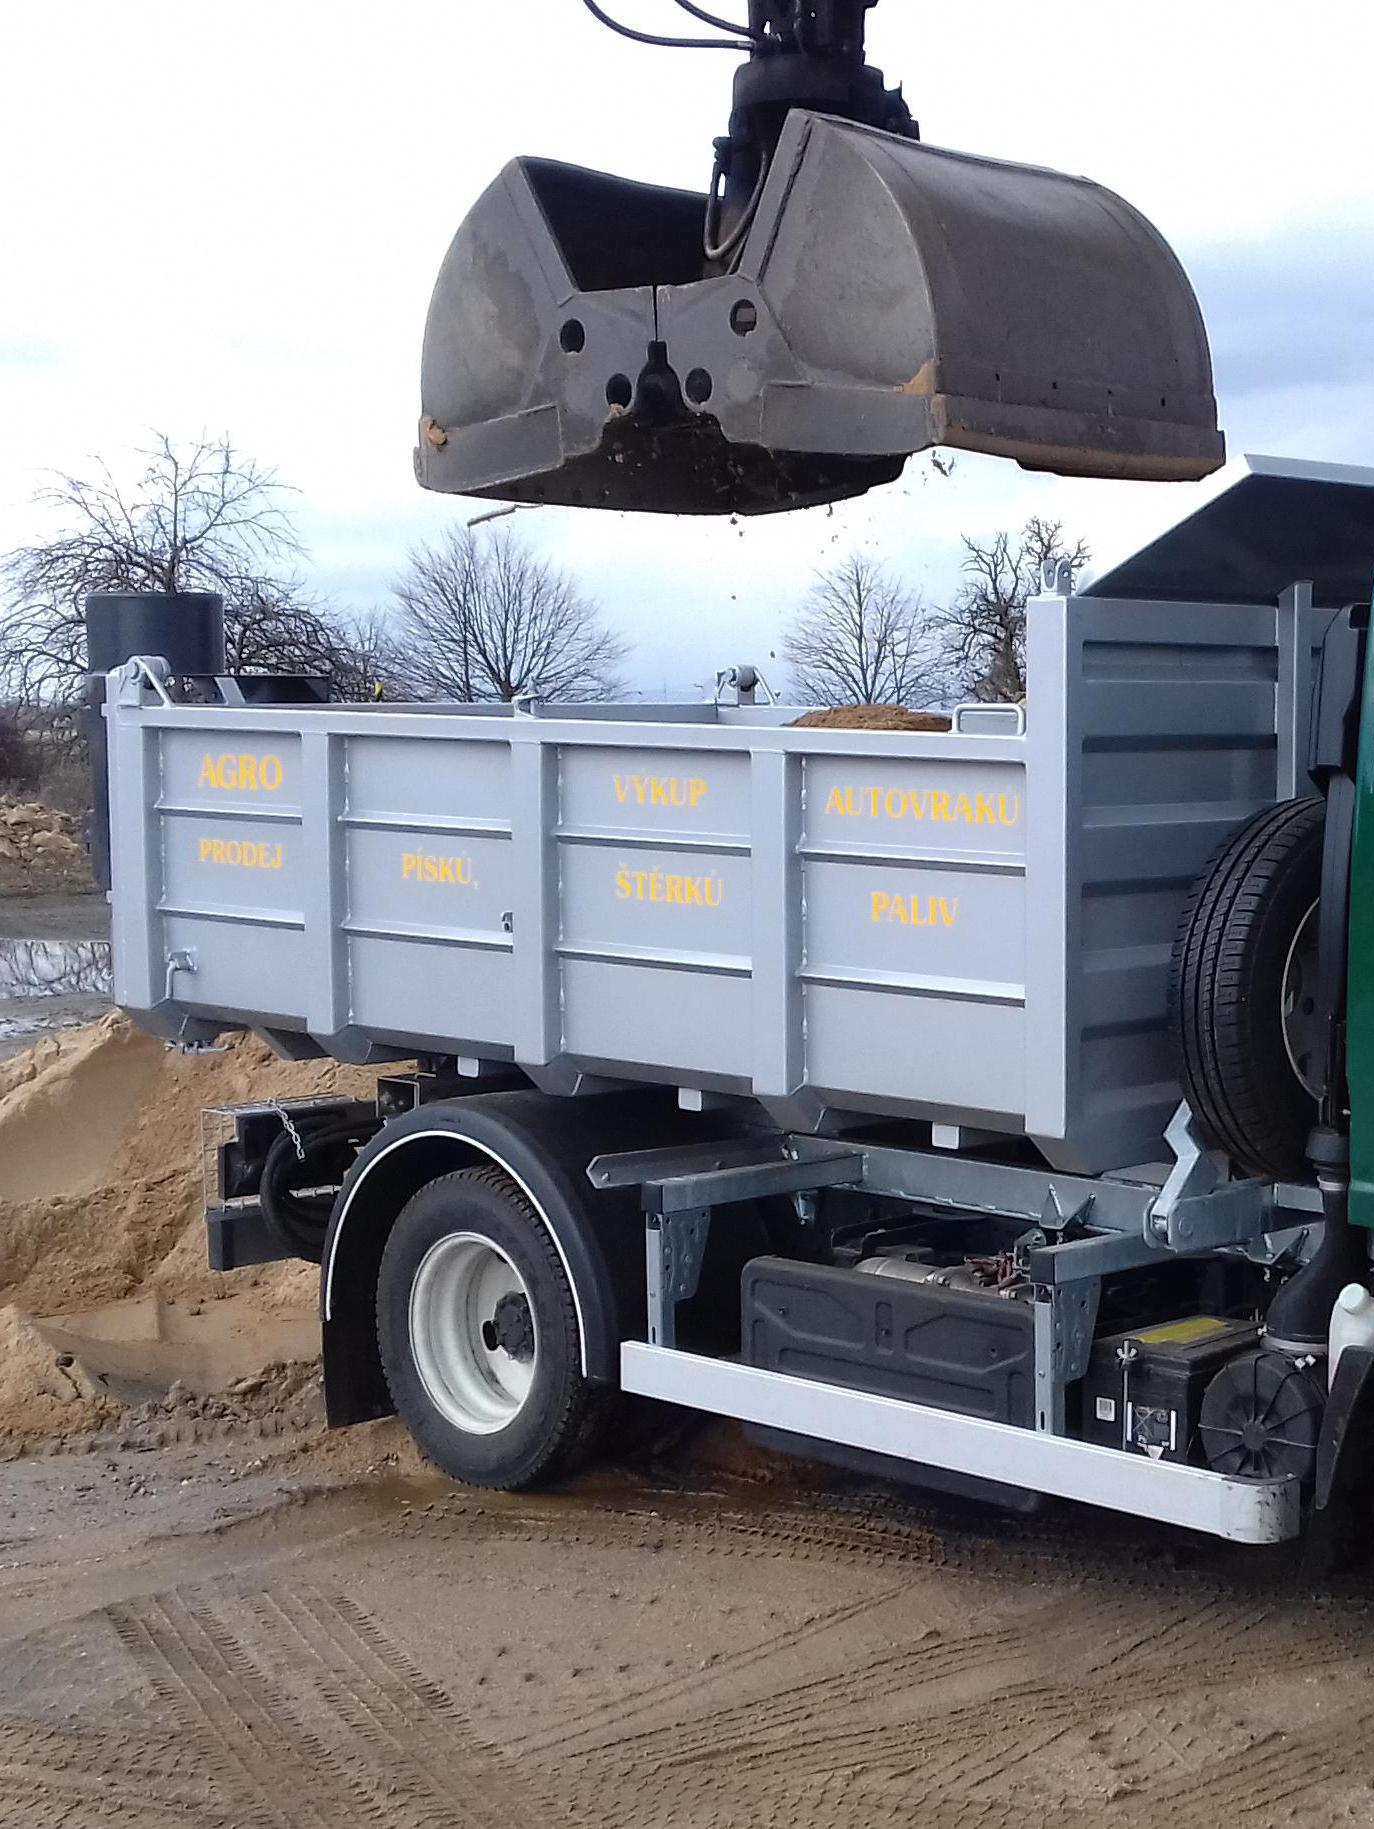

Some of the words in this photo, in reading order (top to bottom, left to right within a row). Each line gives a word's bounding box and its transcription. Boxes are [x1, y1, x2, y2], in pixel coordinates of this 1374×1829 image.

[198, 752, 284, 792] AGRO
[198, 838, 285, 870] PRODEJ
[869, 890, 960, 929] PALIV
